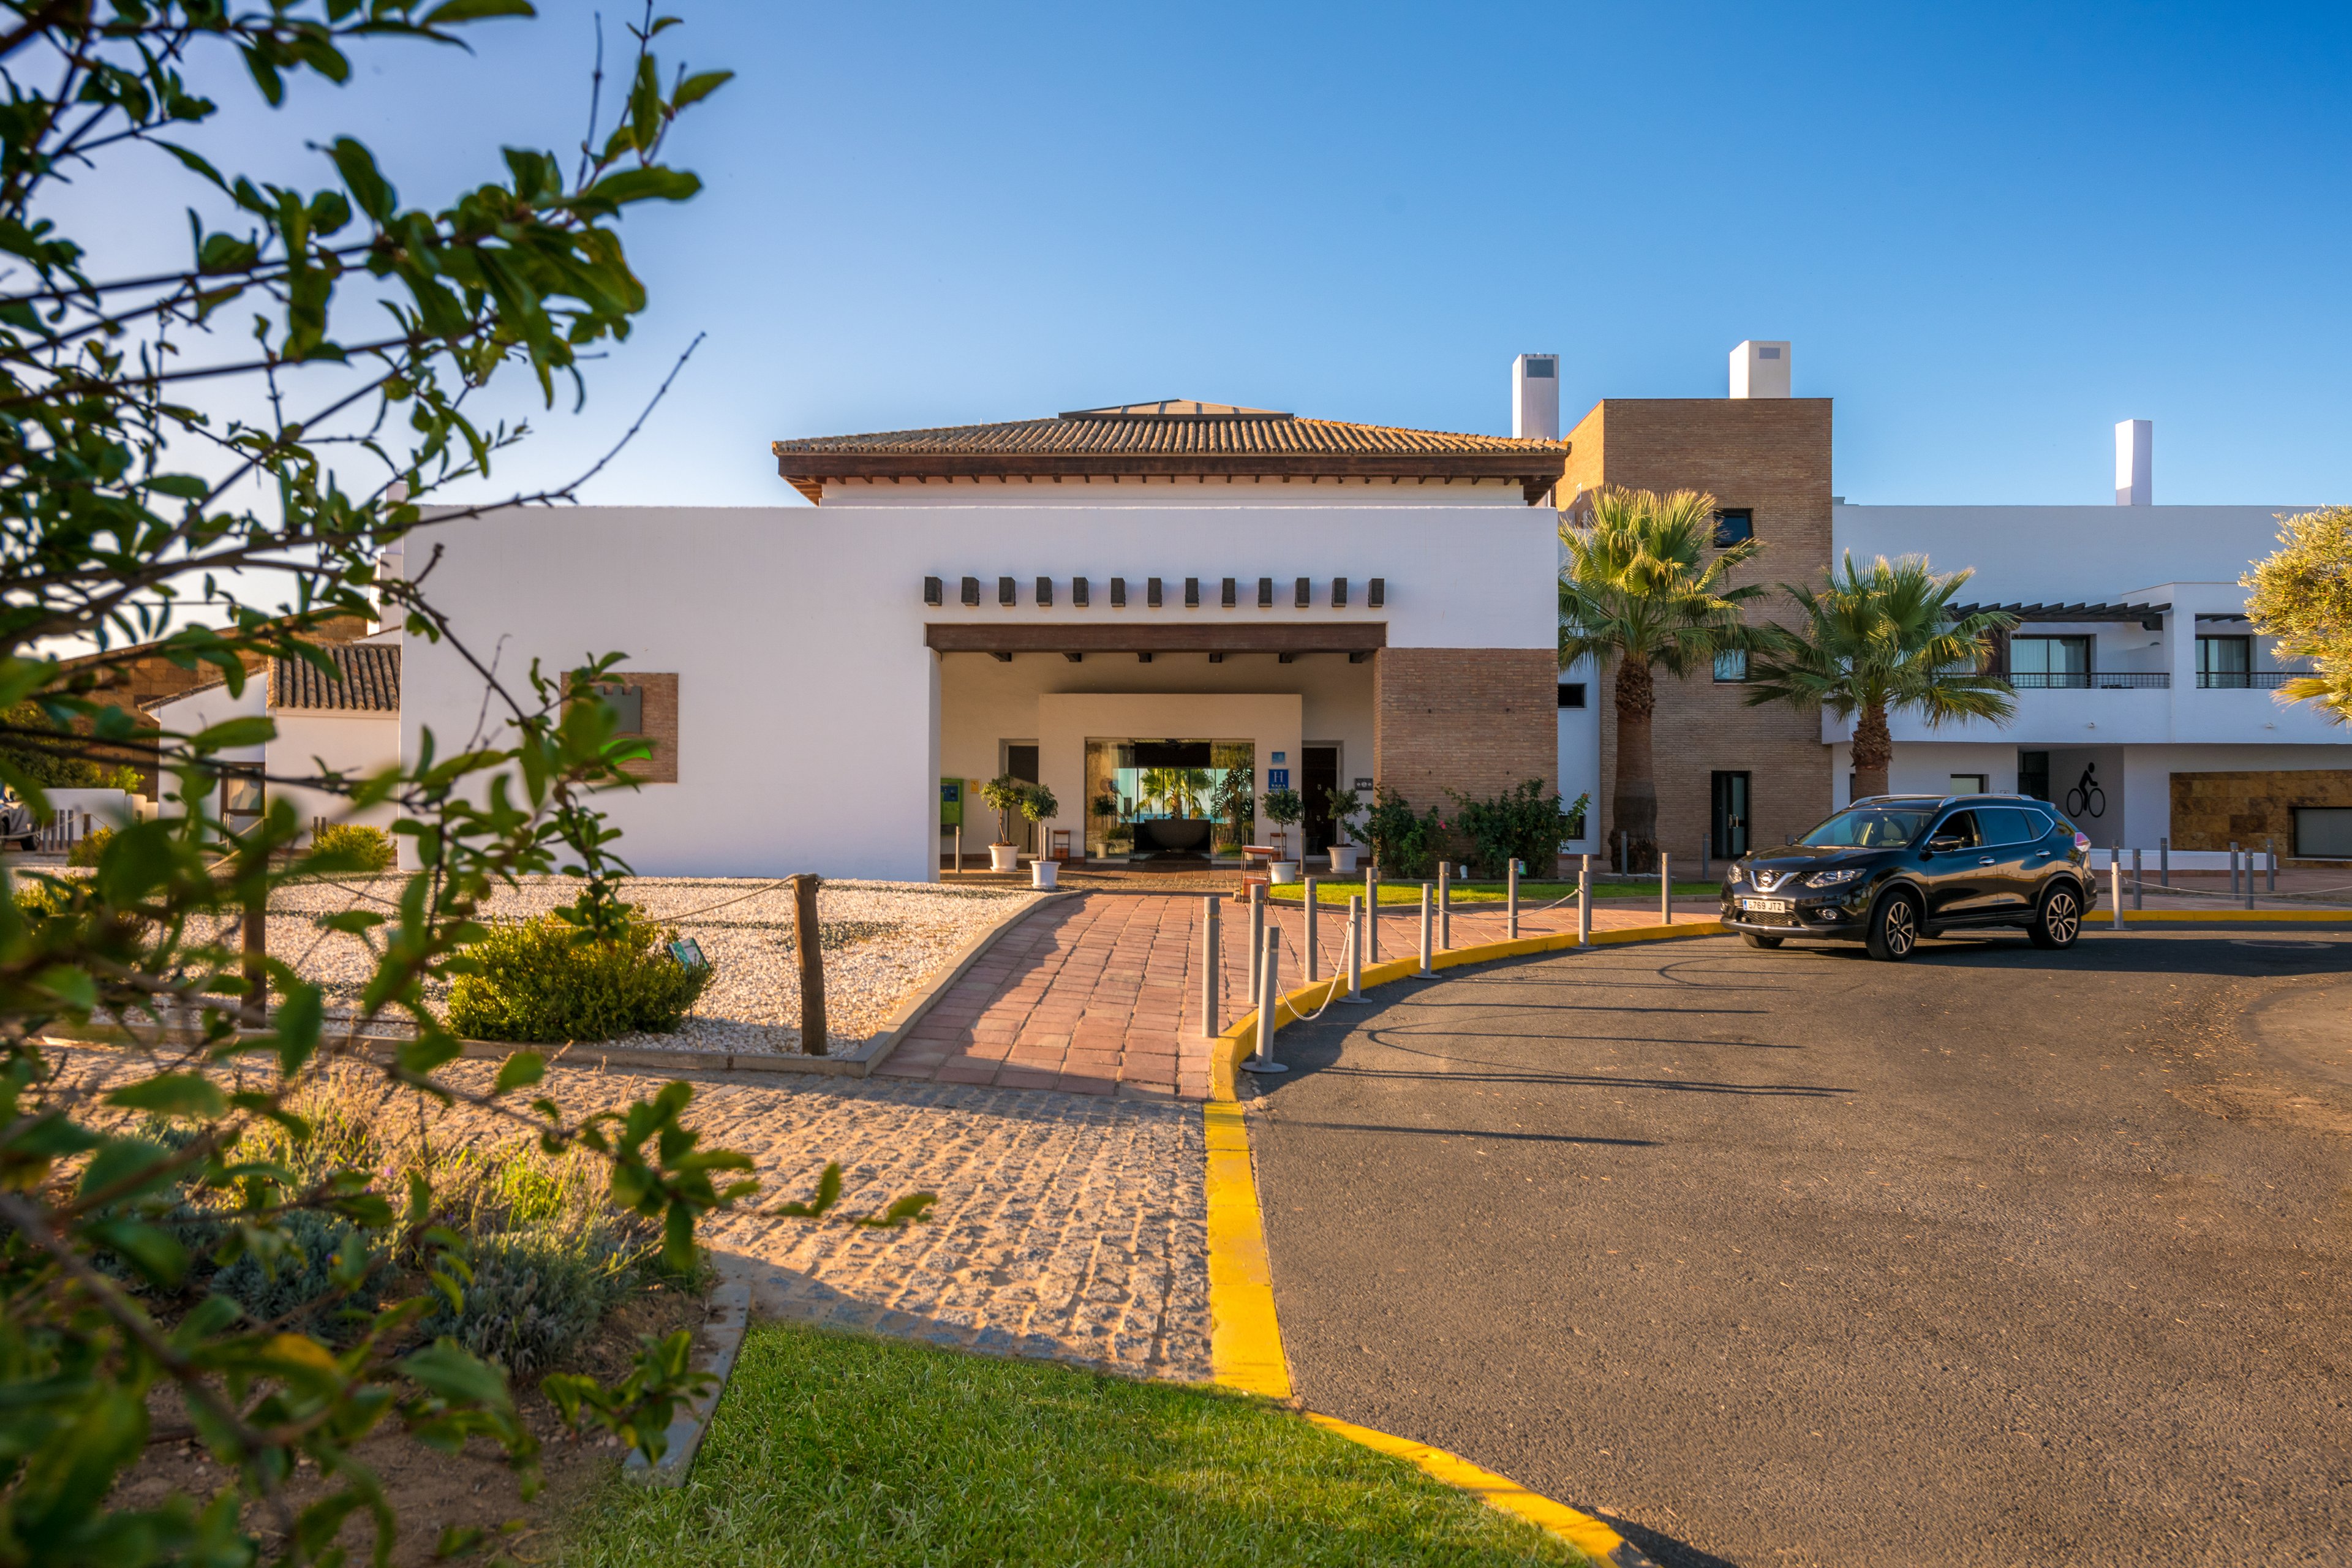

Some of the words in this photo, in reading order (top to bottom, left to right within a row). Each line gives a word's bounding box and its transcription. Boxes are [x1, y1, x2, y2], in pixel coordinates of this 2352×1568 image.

[1274, 772, 1283, 783] H
[1748, 901, 1765, 910] 5769
[1768, 902, 1782, 911] JTZ
